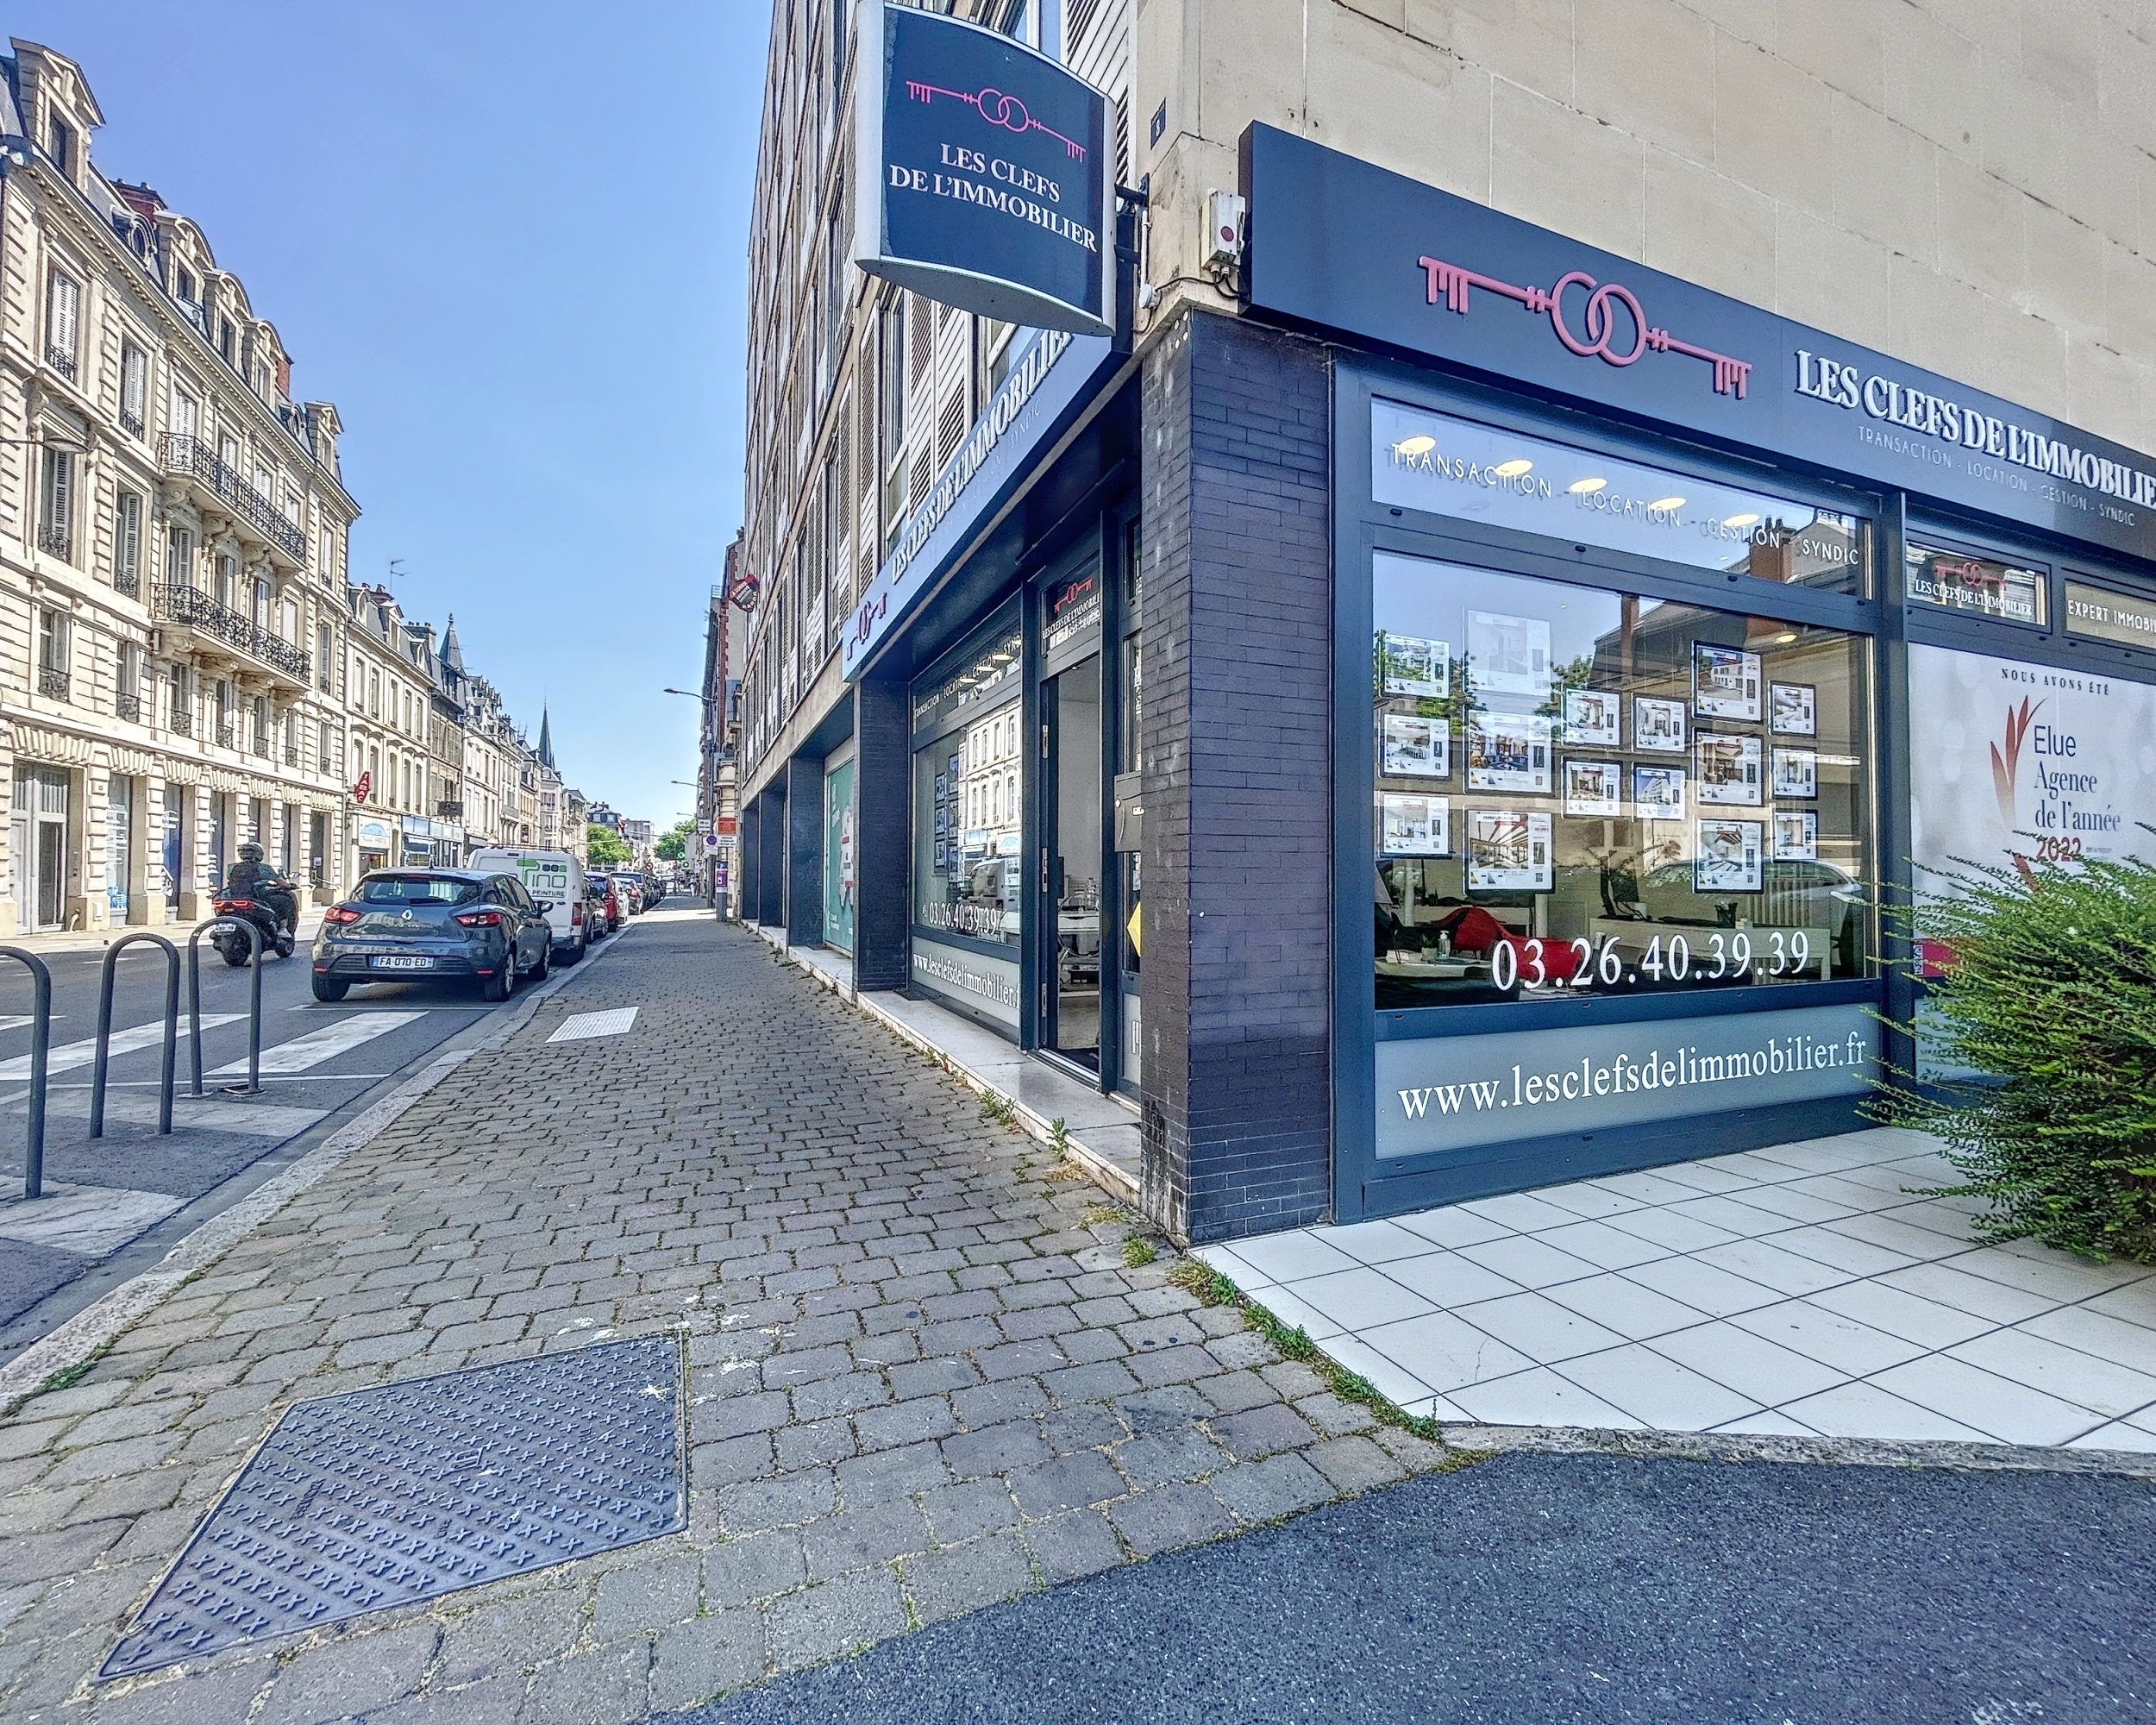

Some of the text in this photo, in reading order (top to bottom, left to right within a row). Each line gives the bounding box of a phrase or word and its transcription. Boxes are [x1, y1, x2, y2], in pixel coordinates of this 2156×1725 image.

[940, 142, 1061, 204] LES CLEFS
[889, 164, 1097, 253] DE L'IMMOBILIER
[1796, 349, 1859, 409] LES
[1863, 374, 1959, 442] CLEFS
[1961, 407, 2005, 457] DE
[1858, 425, 2135, 527] TRANSACTION LOCATION GESTION SYNDIC
[1389, 442, 1859, 566] TRANSACTION LOCATION GESTION SYNDIC
[892, 541, 908, 586] LES
[906, 497, 937, 562] CLEFS
[936, 471, 956, 524] DE
[1915, 579, 1932, 595] LES
[1960, 590, 1974, 604] DE
[2067, 599, 2109, 622] EXPERT
[2002, 668, 2110, 696] NOUS AVONS ÉTÉ
[2034, 724, 2077, 757] Elue
[358, 774, 369, 802] TABAC
[2034, 760, 2097, 800] Agence
[2035, 800, 2122, 832] de l'année
[2035, 836, 2082, 862] 2022
[929, 901, 997, 936] 03.26.40.39.39
[1492, 930, 1809, 991] 03.26.40.39.39
[1398, 1031, 1866, 1120] www.lesclefsdelimmobilier.fr
